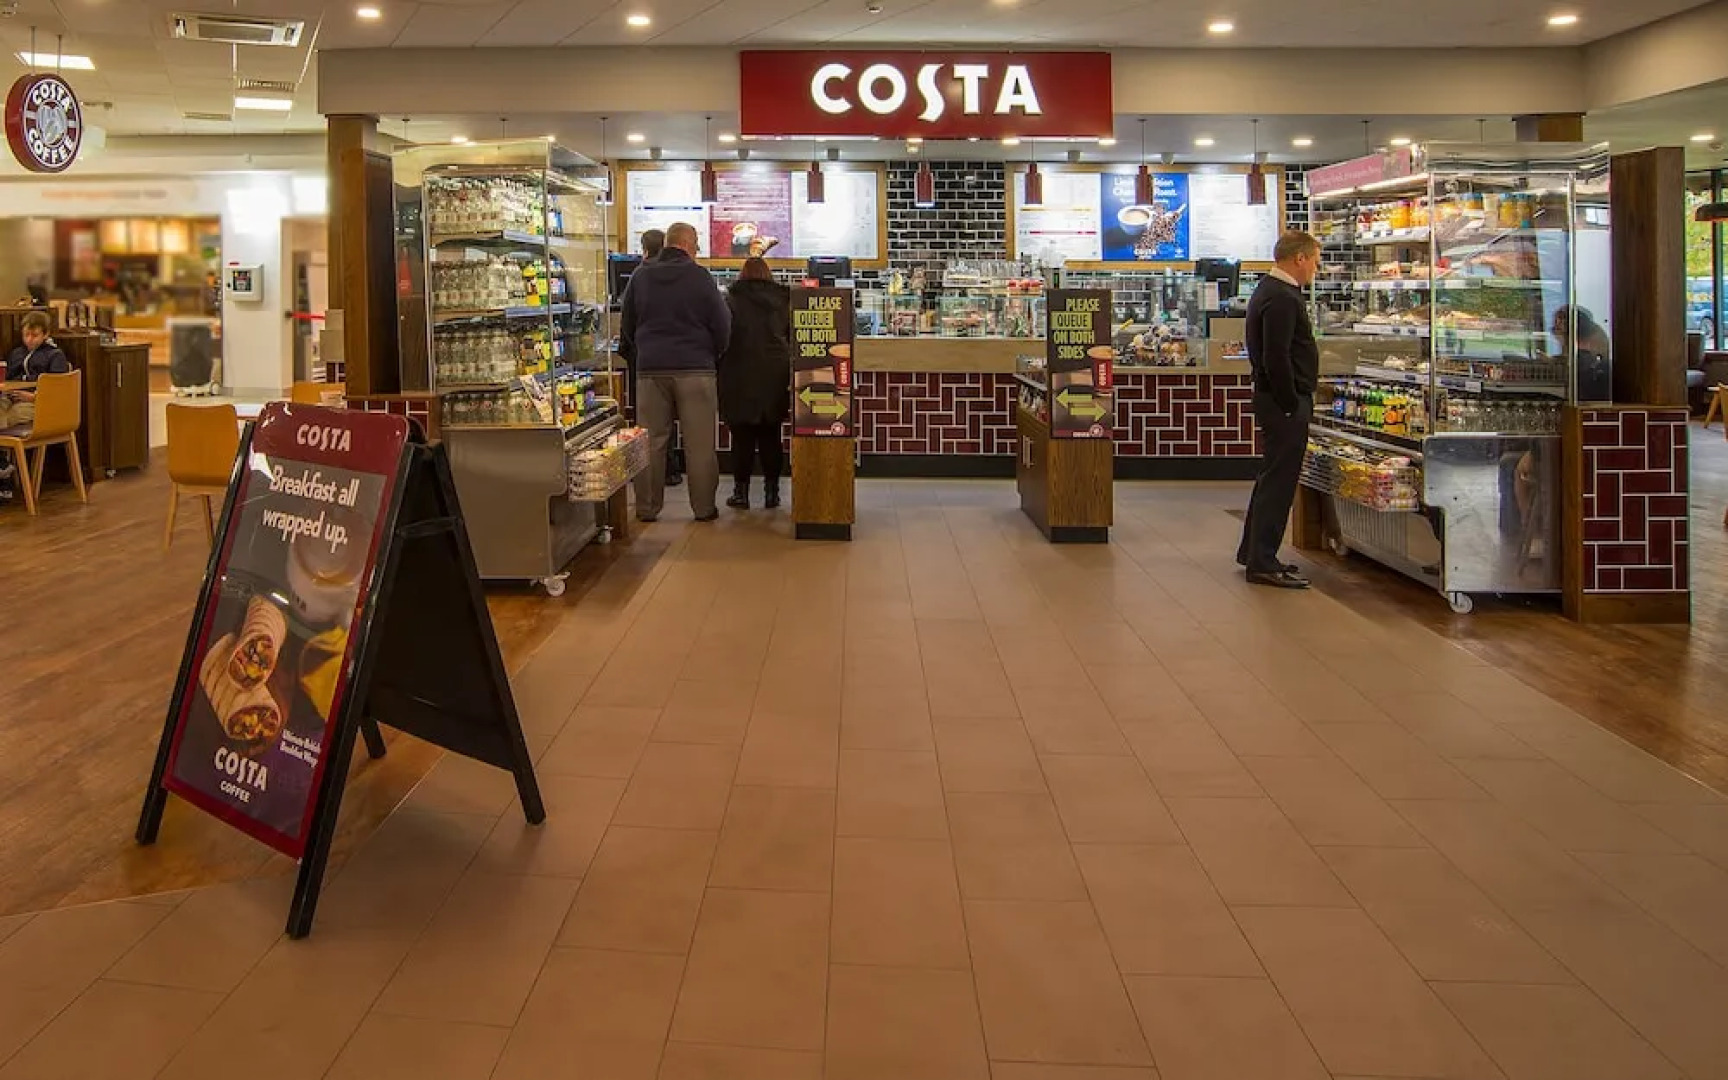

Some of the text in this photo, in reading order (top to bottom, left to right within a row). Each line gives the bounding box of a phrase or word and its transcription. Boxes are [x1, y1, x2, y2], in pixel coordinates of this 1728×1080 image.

[32, 83, 72, 113] COSTA
[811, 62, 1043, 122] COSTA
[29, 128, 74, 164] COFFEE
[808, 296, 843, 310] PLEASE
[1066, 298, 1100, 312] PLEASE
[799, 312, 831, 326] QUEUE
[1057, 314, 1088, 328] QUEUE
[796, 329, 837, 343] ON BOTH
[1053, 330, 1095, 344] ON BOTH
[800, 343, 827, 357] SIDES
[1058, 345, 1085, 358] SIDES
[296, 424, 351, 451] COSTA
[269, 464, 360, 507] Breakfast all
[262, 509, 348, 553] wrapped up.
[215, 747, 268, 791] COSTA
[220, 780, 251, 803] COFFEE
